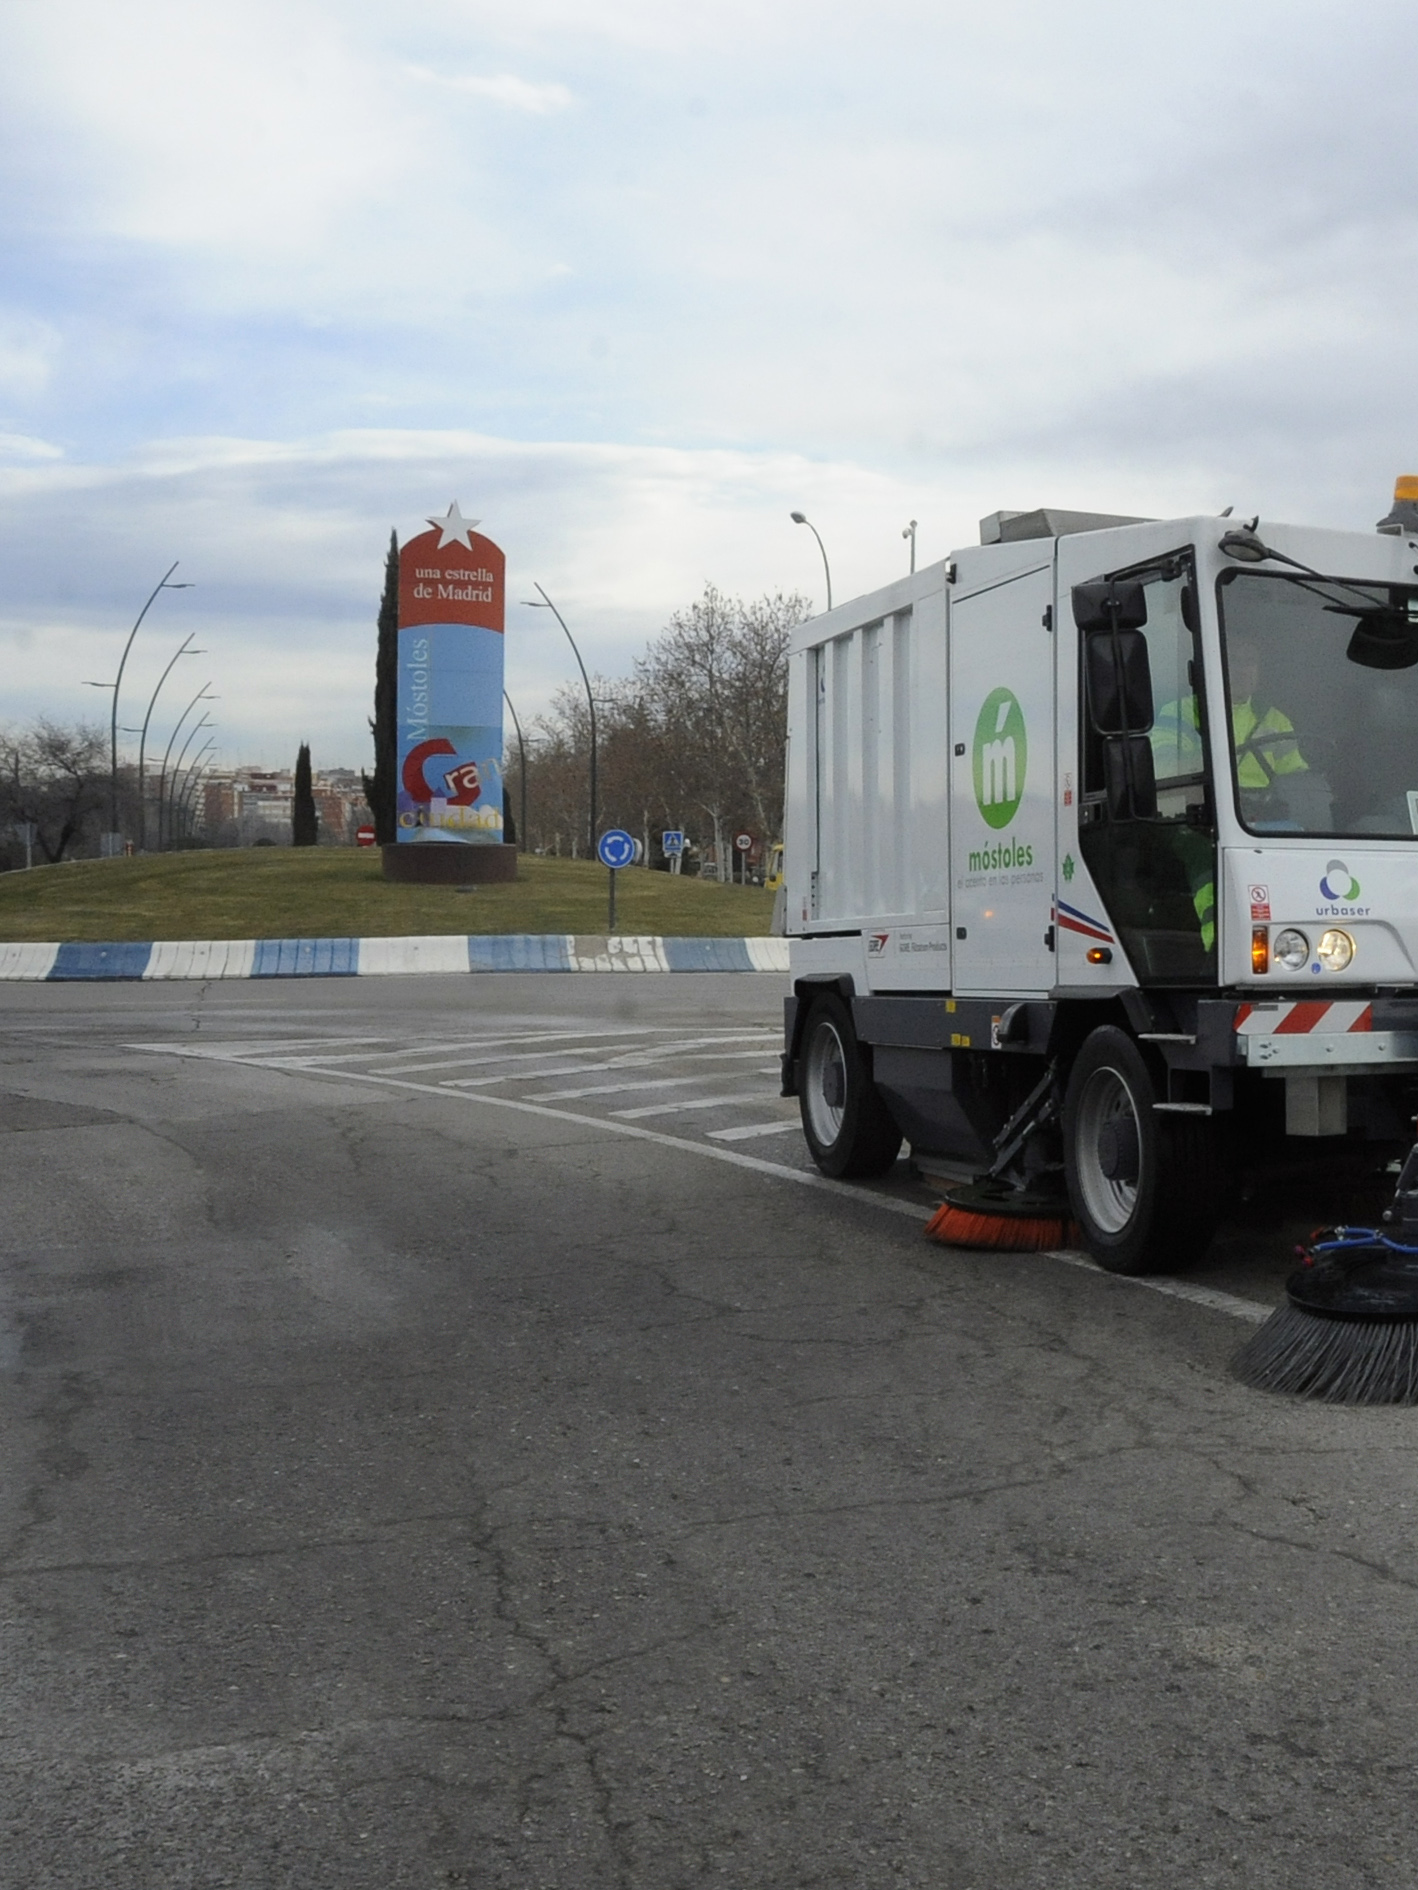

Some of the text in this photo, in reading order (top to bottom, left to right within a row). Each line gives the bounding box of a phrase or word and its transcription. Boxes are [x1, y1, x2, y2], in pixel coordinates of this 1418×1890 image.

[415, 568, 494, 582] una estrella
[413, 583, 492, 603] de Madrid
[406, 638, 428, 740] Móstoles
[399, 805, 500, 829] ciudad
[968, 836, 1033, 873] móstoles
[1315, 904, 1371, 916] urbaser
